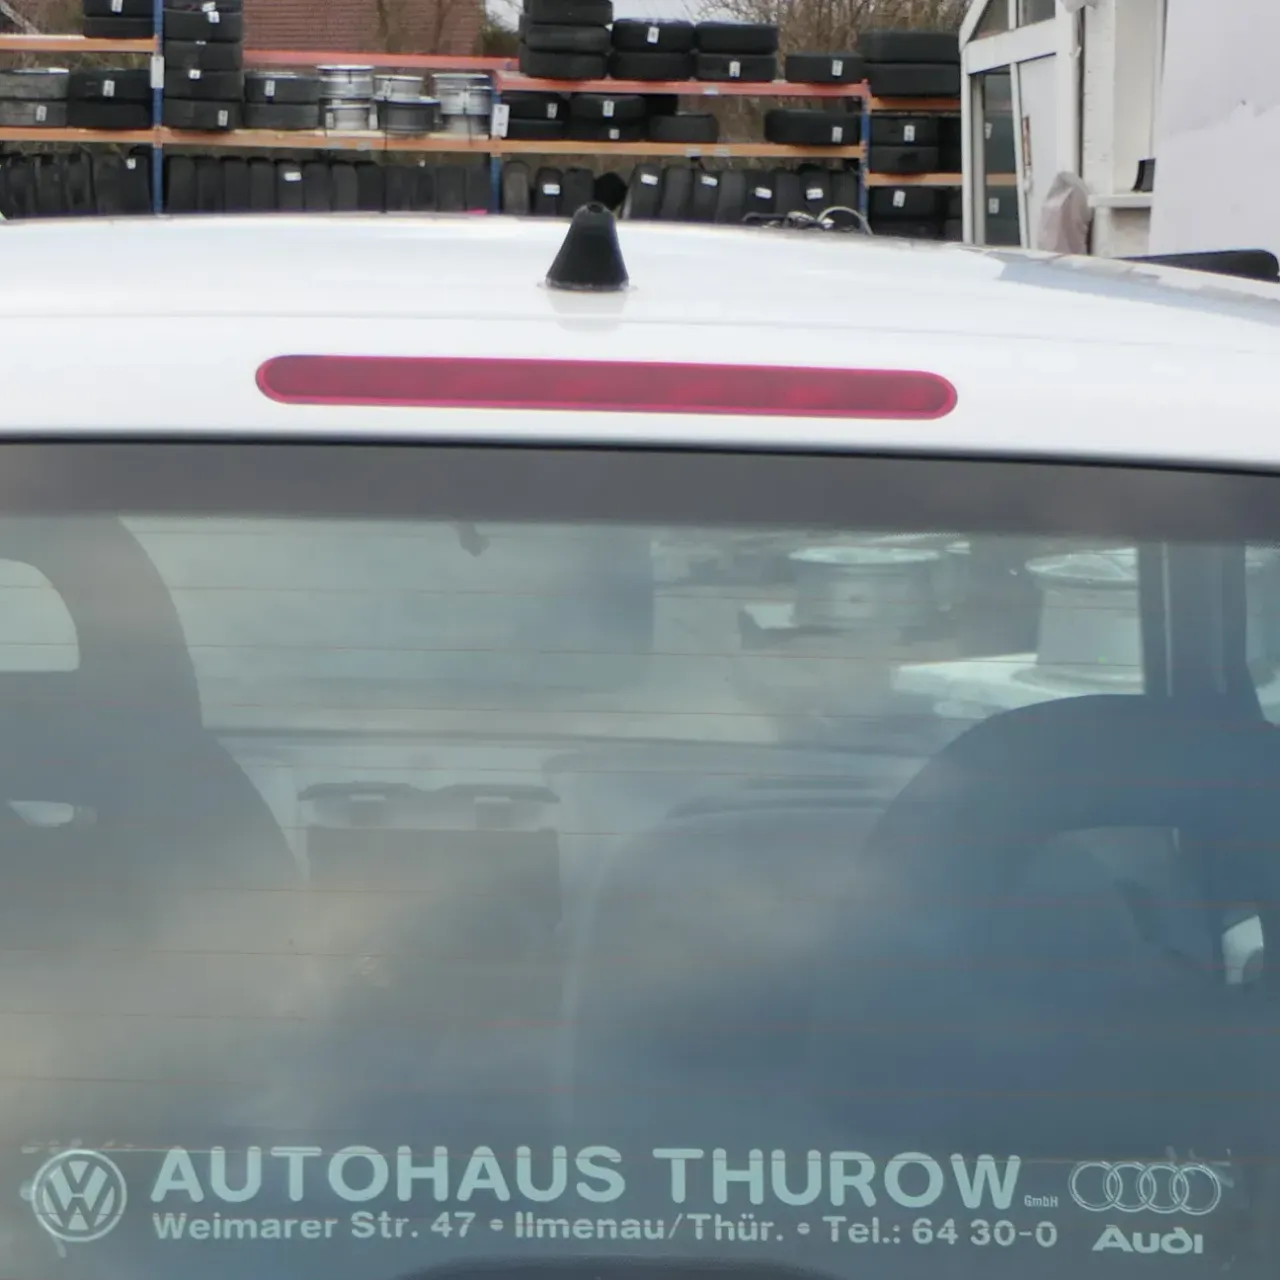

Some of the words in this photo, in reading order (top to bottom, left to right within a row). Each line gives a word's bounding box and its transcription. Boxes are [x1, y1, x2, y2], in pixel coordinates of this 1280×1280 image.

[150, 1145, 626, 1202] AUTOHAUS
[652, 1147, 1021, 1209] THUROW
[153, 1211, 337, 1240] Weimarer
[351, 1210, 418, 1239] Str.
[430, 1211, 475, 1237] 47
[822, 1214, 899, 1244] Tel.:
[911, 1217, 958, 1244] 64
[970, 1218, 1057, 1246] 30-0
[1092, 1226, 1203, 1254] Audi
